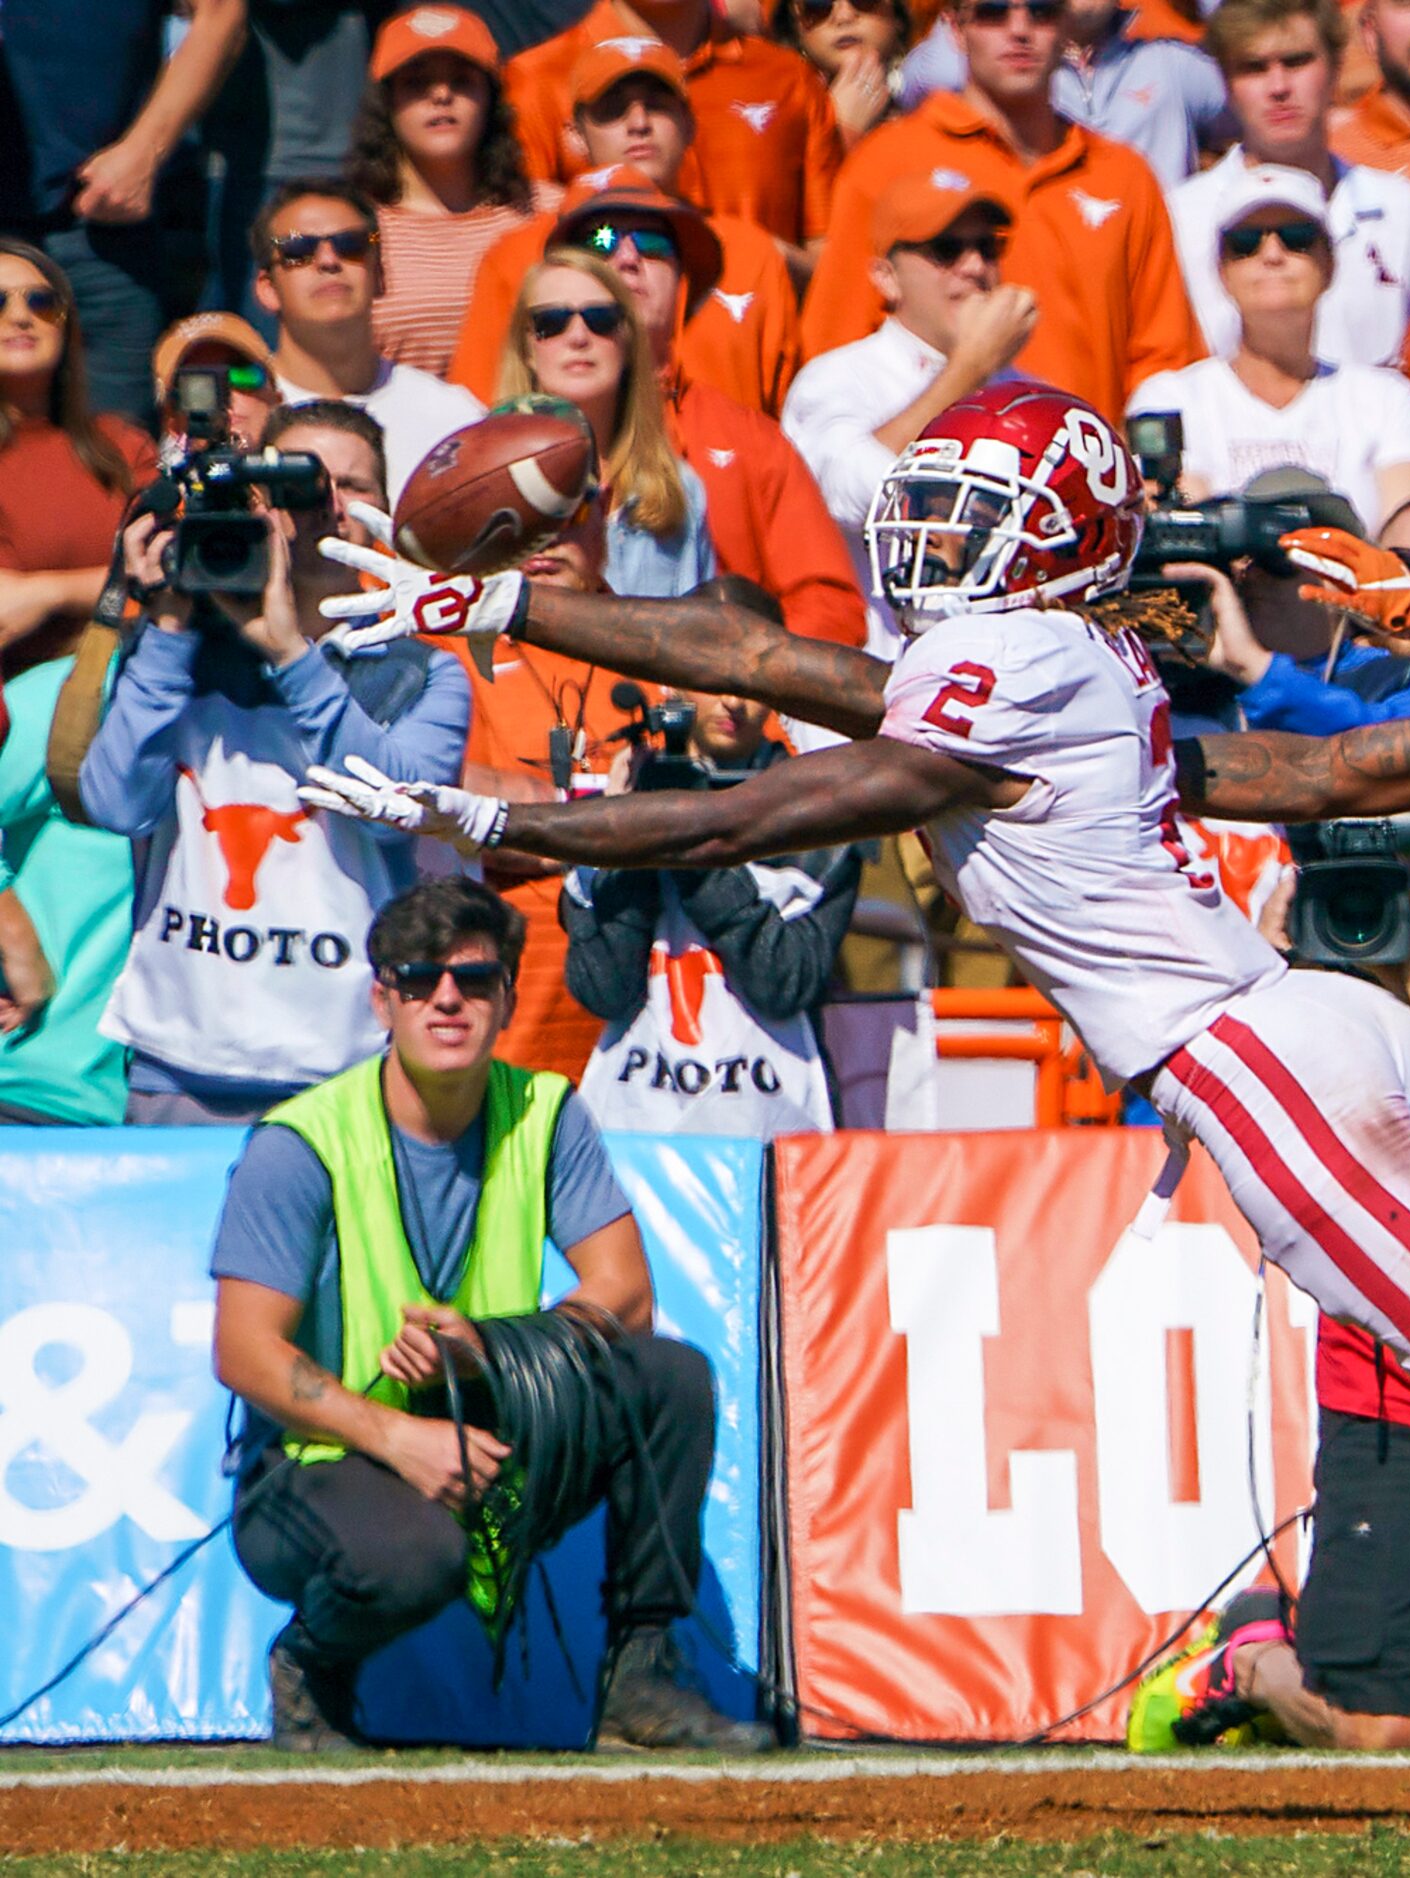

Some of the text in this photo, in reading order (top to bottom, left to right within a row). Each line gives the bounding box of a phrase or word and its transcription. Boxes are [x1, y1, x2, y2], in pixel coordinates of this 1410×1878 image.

[1064, 408, 1128, 506] OU
[921, 660, 997, 740] 2
[159, 905, 351, 969] PHOTO
